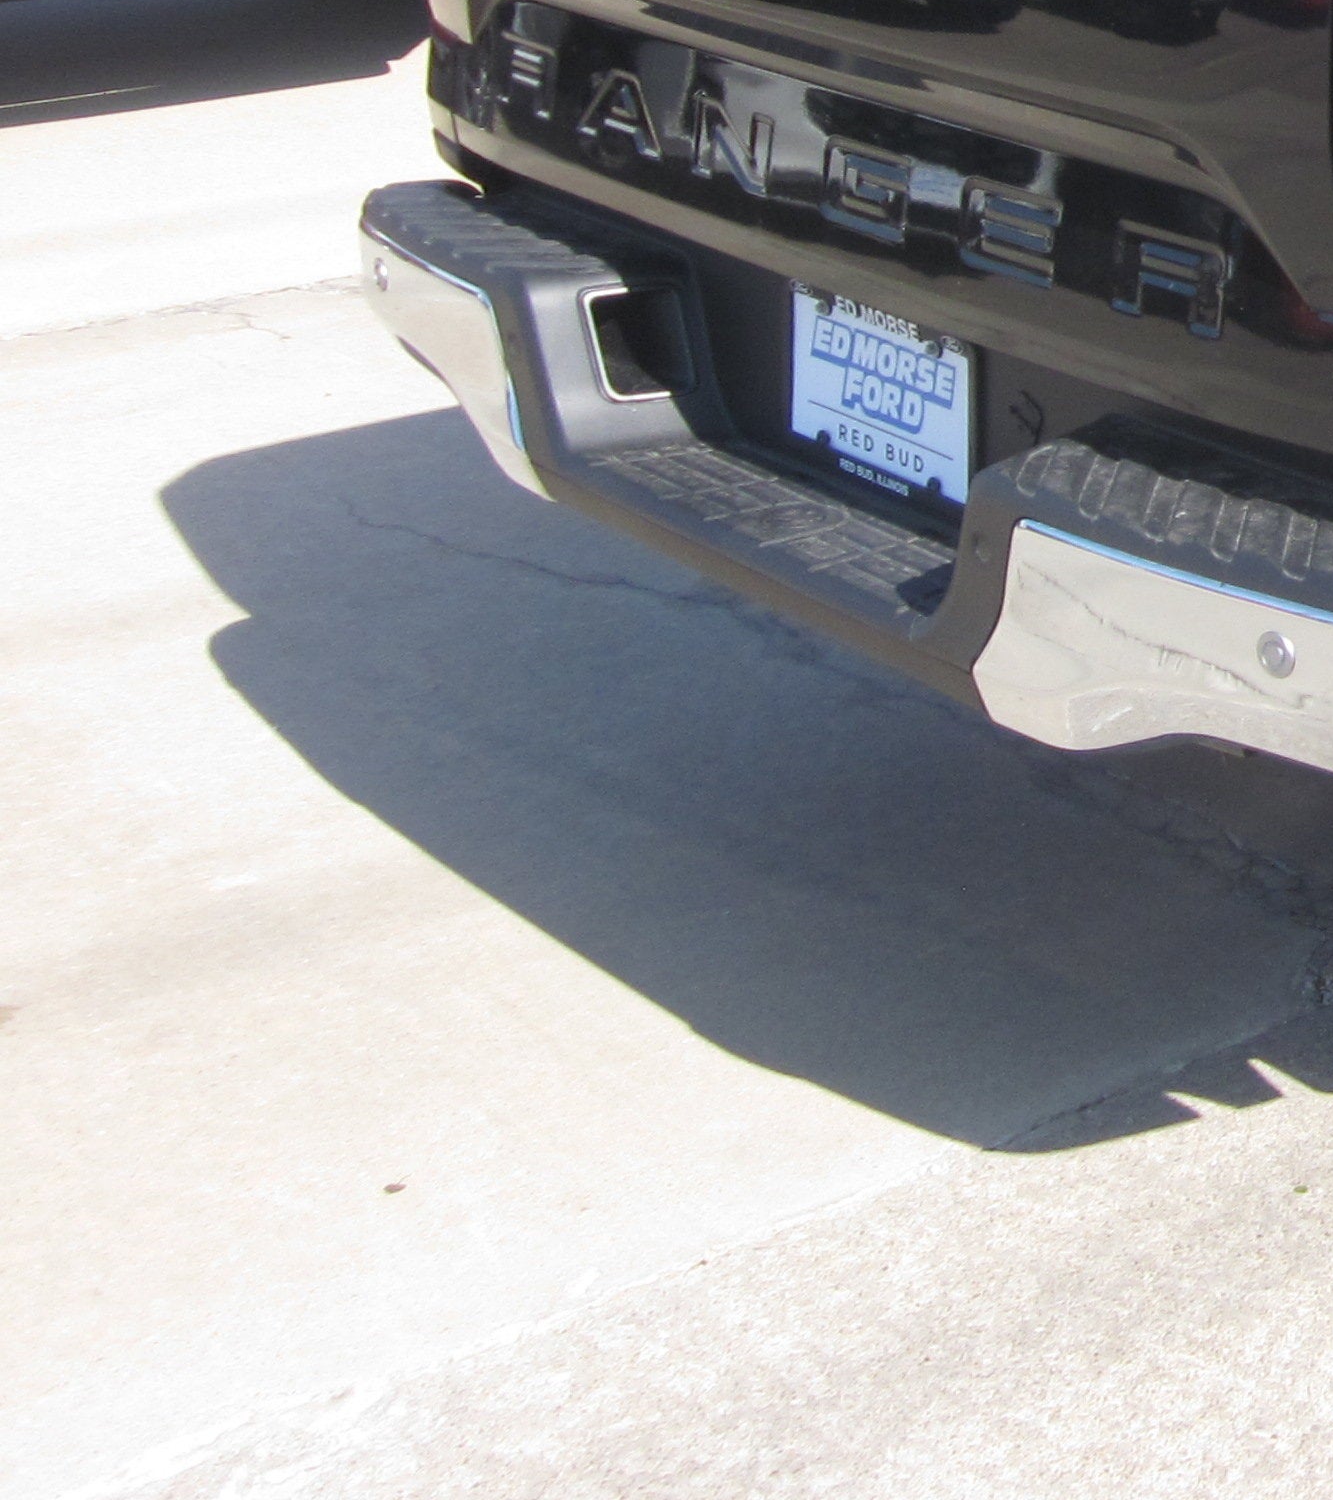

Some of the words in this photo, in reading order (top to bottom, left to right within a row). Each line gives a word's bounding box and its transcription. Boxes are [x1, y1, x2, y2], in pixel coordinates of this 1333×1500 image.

[497, 29, 1228, 340] RANGER
[835, 294, 857, 317] ED
[860, 304, 921, 340] MORSE
[812, 317, 850, 361] ED
[852, 331, 955, 404] MORSE
[843, 369, 923, 430] FORD
[838, 423, 875, 453] RED
[885, 443, 925, 473] BUD
